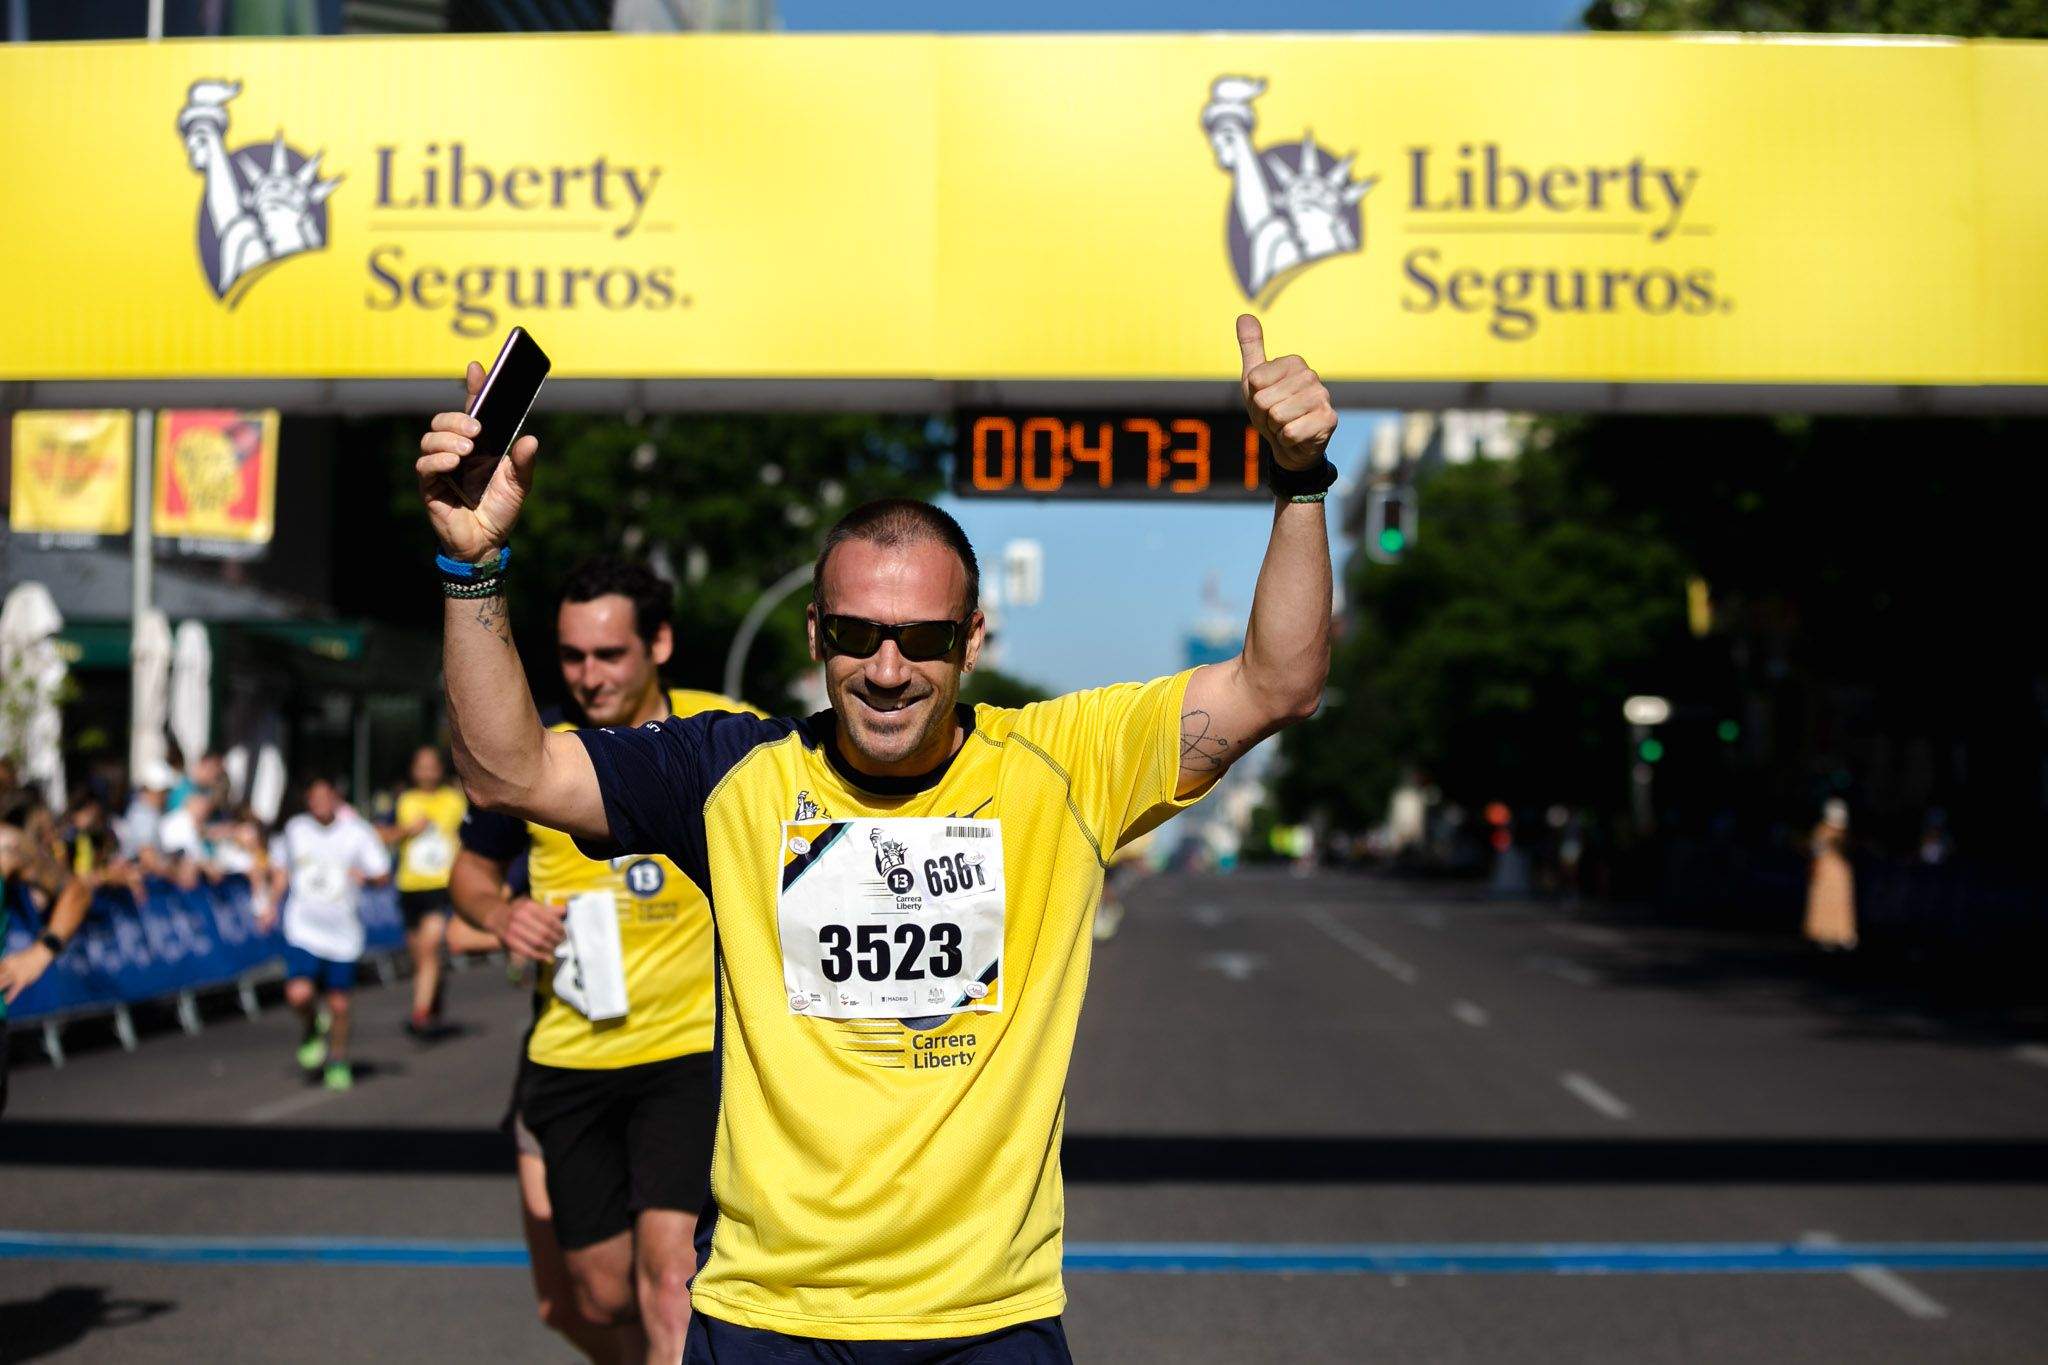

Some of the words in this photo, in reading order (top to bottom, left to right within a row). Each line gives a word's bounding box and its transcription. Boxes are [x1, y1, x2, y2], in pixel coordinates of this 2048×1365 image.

[372, 142, 662, 239] Liberty
[1407, 143, 1700, 241] Liberty
[365, 246, 694, 338] Seguros.
[631, 863, 660, 891] 13
[892, 873, 909, 889] 13
[819, 923, 962, 982] 3523
[912, 1033, 976, 1050] Carrera
[913, 1051, 976, 1069] Liberty
